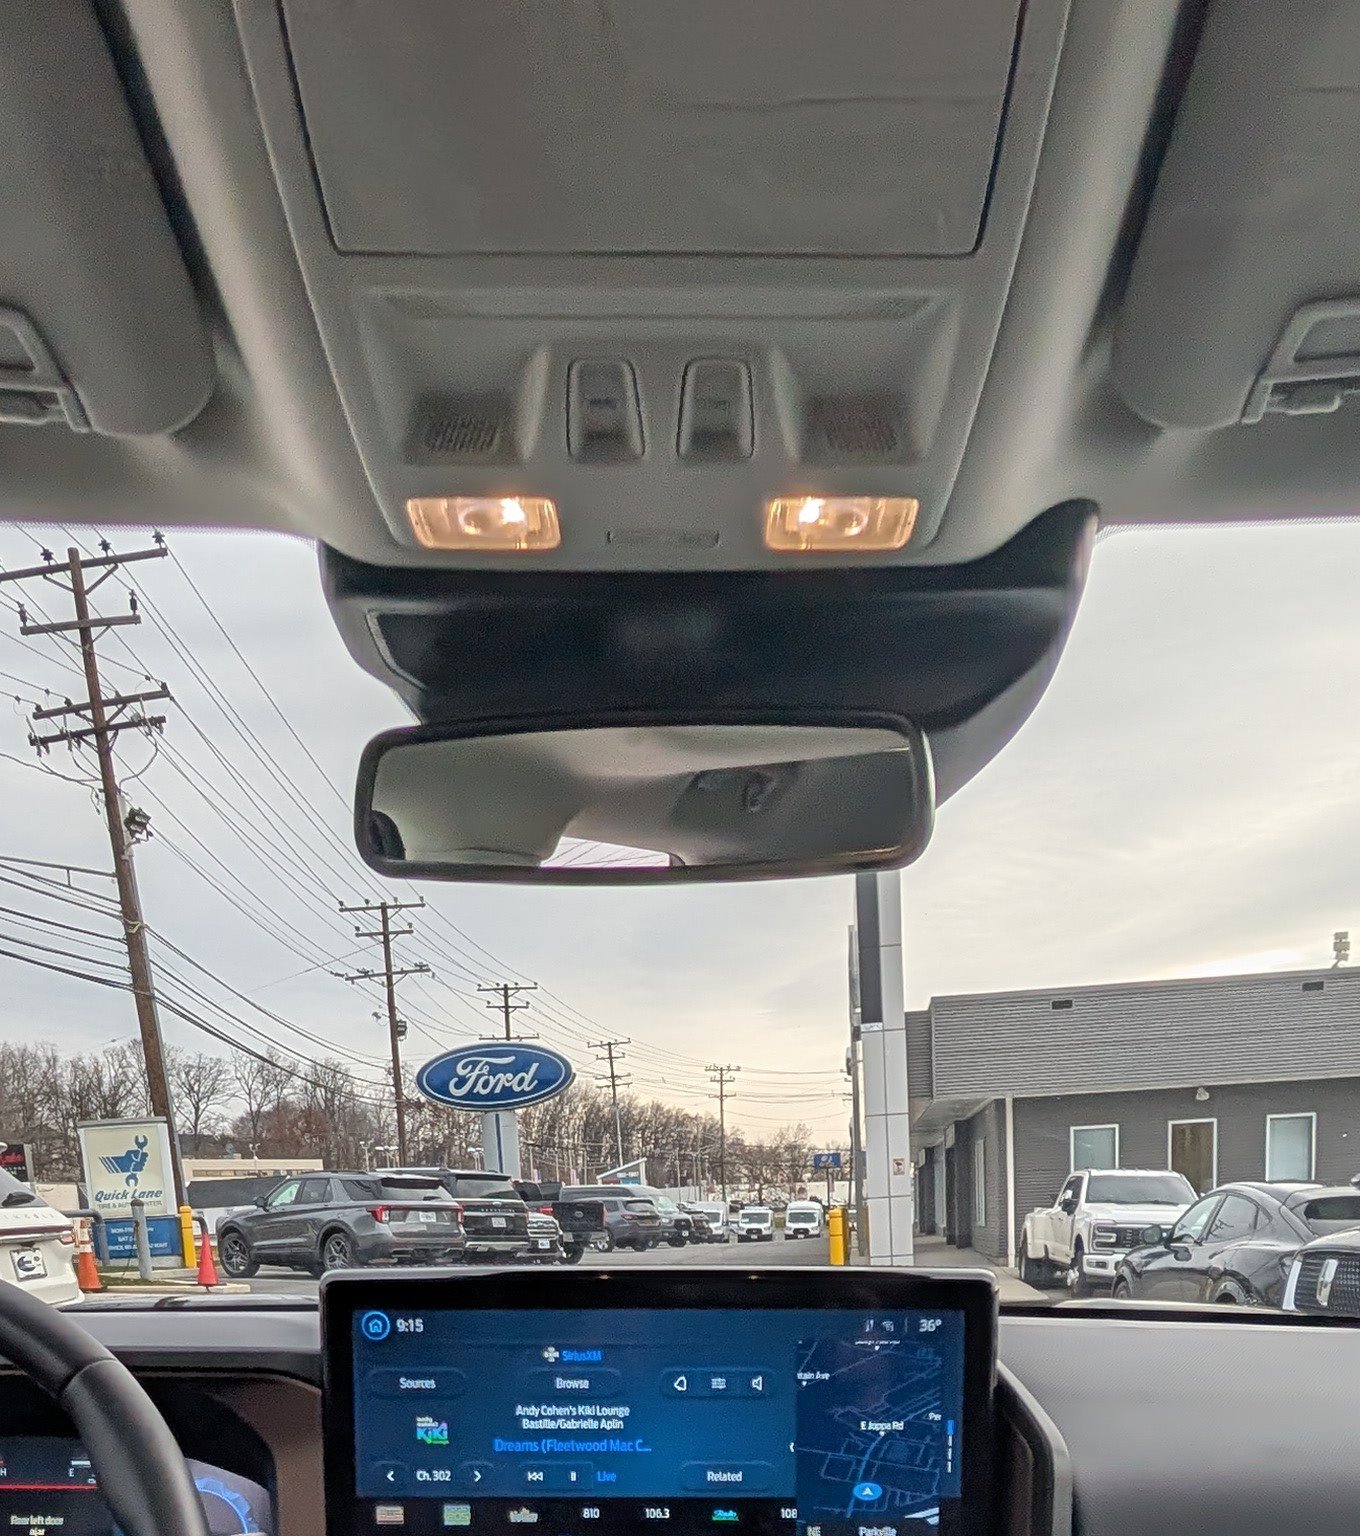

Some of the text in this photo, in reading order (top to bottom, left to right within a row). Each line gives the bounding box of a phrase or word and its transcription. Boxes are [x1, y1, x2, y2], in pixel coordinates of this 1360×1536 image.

[448, 1055, 538, 1097] Ford
[95, 1188, 163, 1201] Quick Lane
[397, 1319, 424, 1332] 9:15
[918, 1319, 942, 1332] 36°
[562, 1350, 602, 1362] SiriusXM
[399, 1378, 436, 1389] Sources
[556, 1378, 589, 1389] Browse
[515, 1405, 630, 1417] Andy Cohen's Kiki Lounge
[600, 1418, 624, 1430] Aplin
[892, 1420, 904, 1430] Rd
[494, 1440, 539, 1451] Dreams
[541, 1439, 607, 1453] (Fleetwood
[609, 1440, 634, 1451] Mac
[0, 1467, 7, 1476] H
[68, 1467, 75, 1477] E
[432, 1470, 451, 1481] 302
[597, 1471, 617, 1482] Live
[707, 1471, 742, 1482] Related
[583, 1508, 600, 1519] 810
[645, 1508, 670, 1519] 106.3
[30, 1515, 44, 1525] left
[45, 1515, 64, 1525] door
[807, 1526, 821, 1536] NE
[858, 1526, 897, 1536] Parkville
